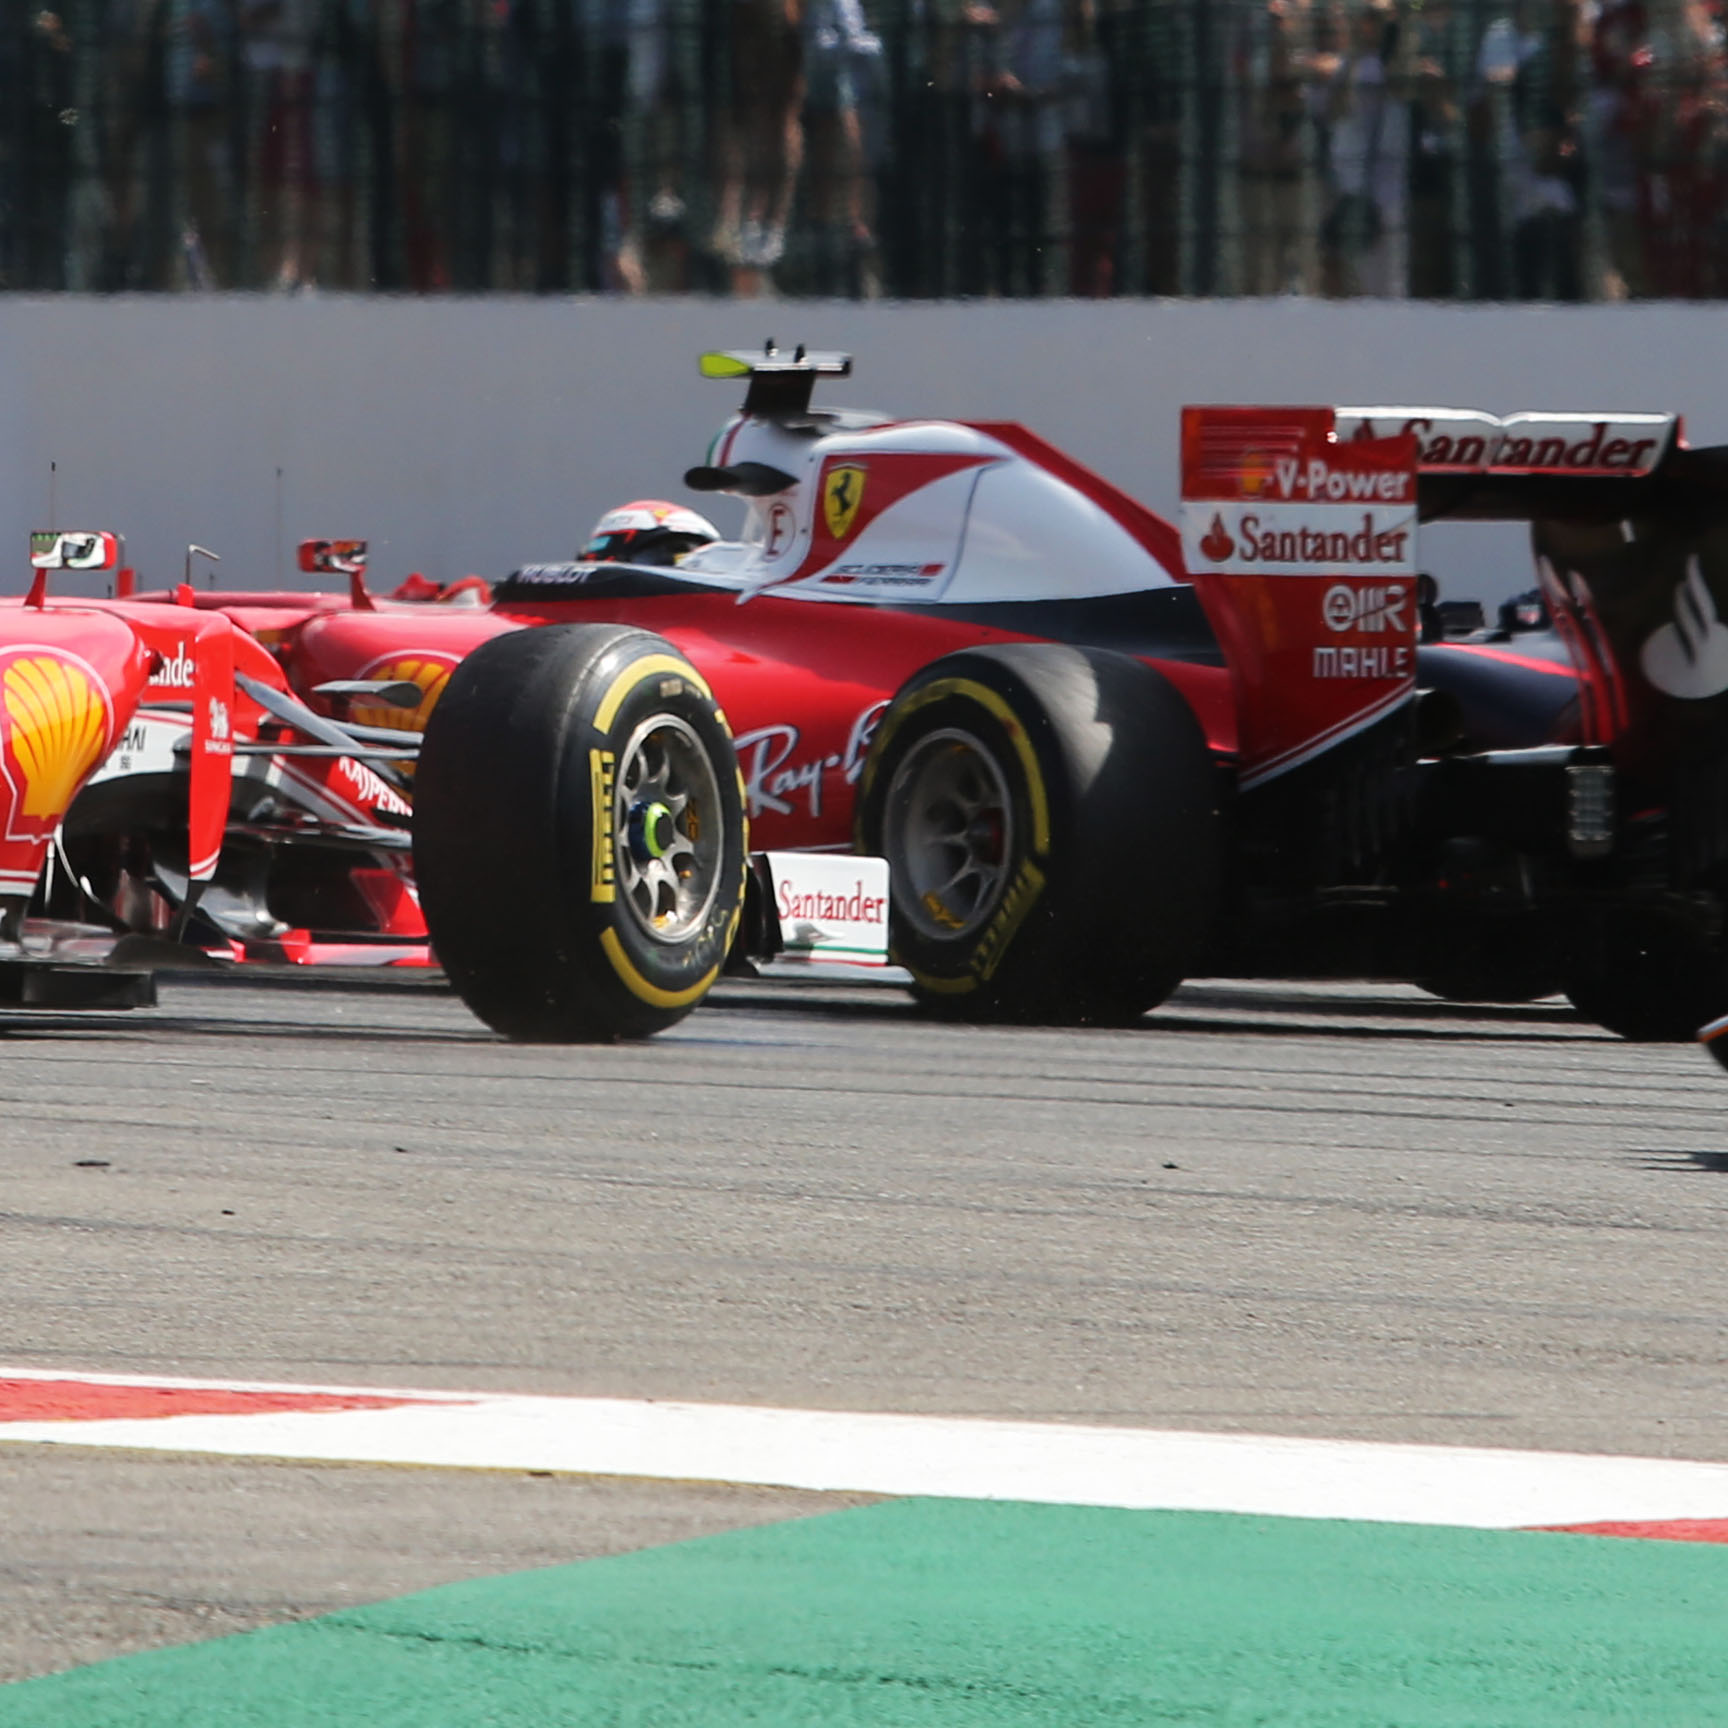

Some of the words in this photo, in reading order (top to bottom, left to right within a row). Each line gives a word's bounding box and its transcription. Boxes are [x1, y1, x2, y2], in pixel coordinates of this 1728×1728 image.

[1275, 458, 1410, 500] V-Power
[1239, 512, 1410, 564] Santander
[1313, 647, 1410, 679] MAHLE
[777, 879, 884, 924] Santander
